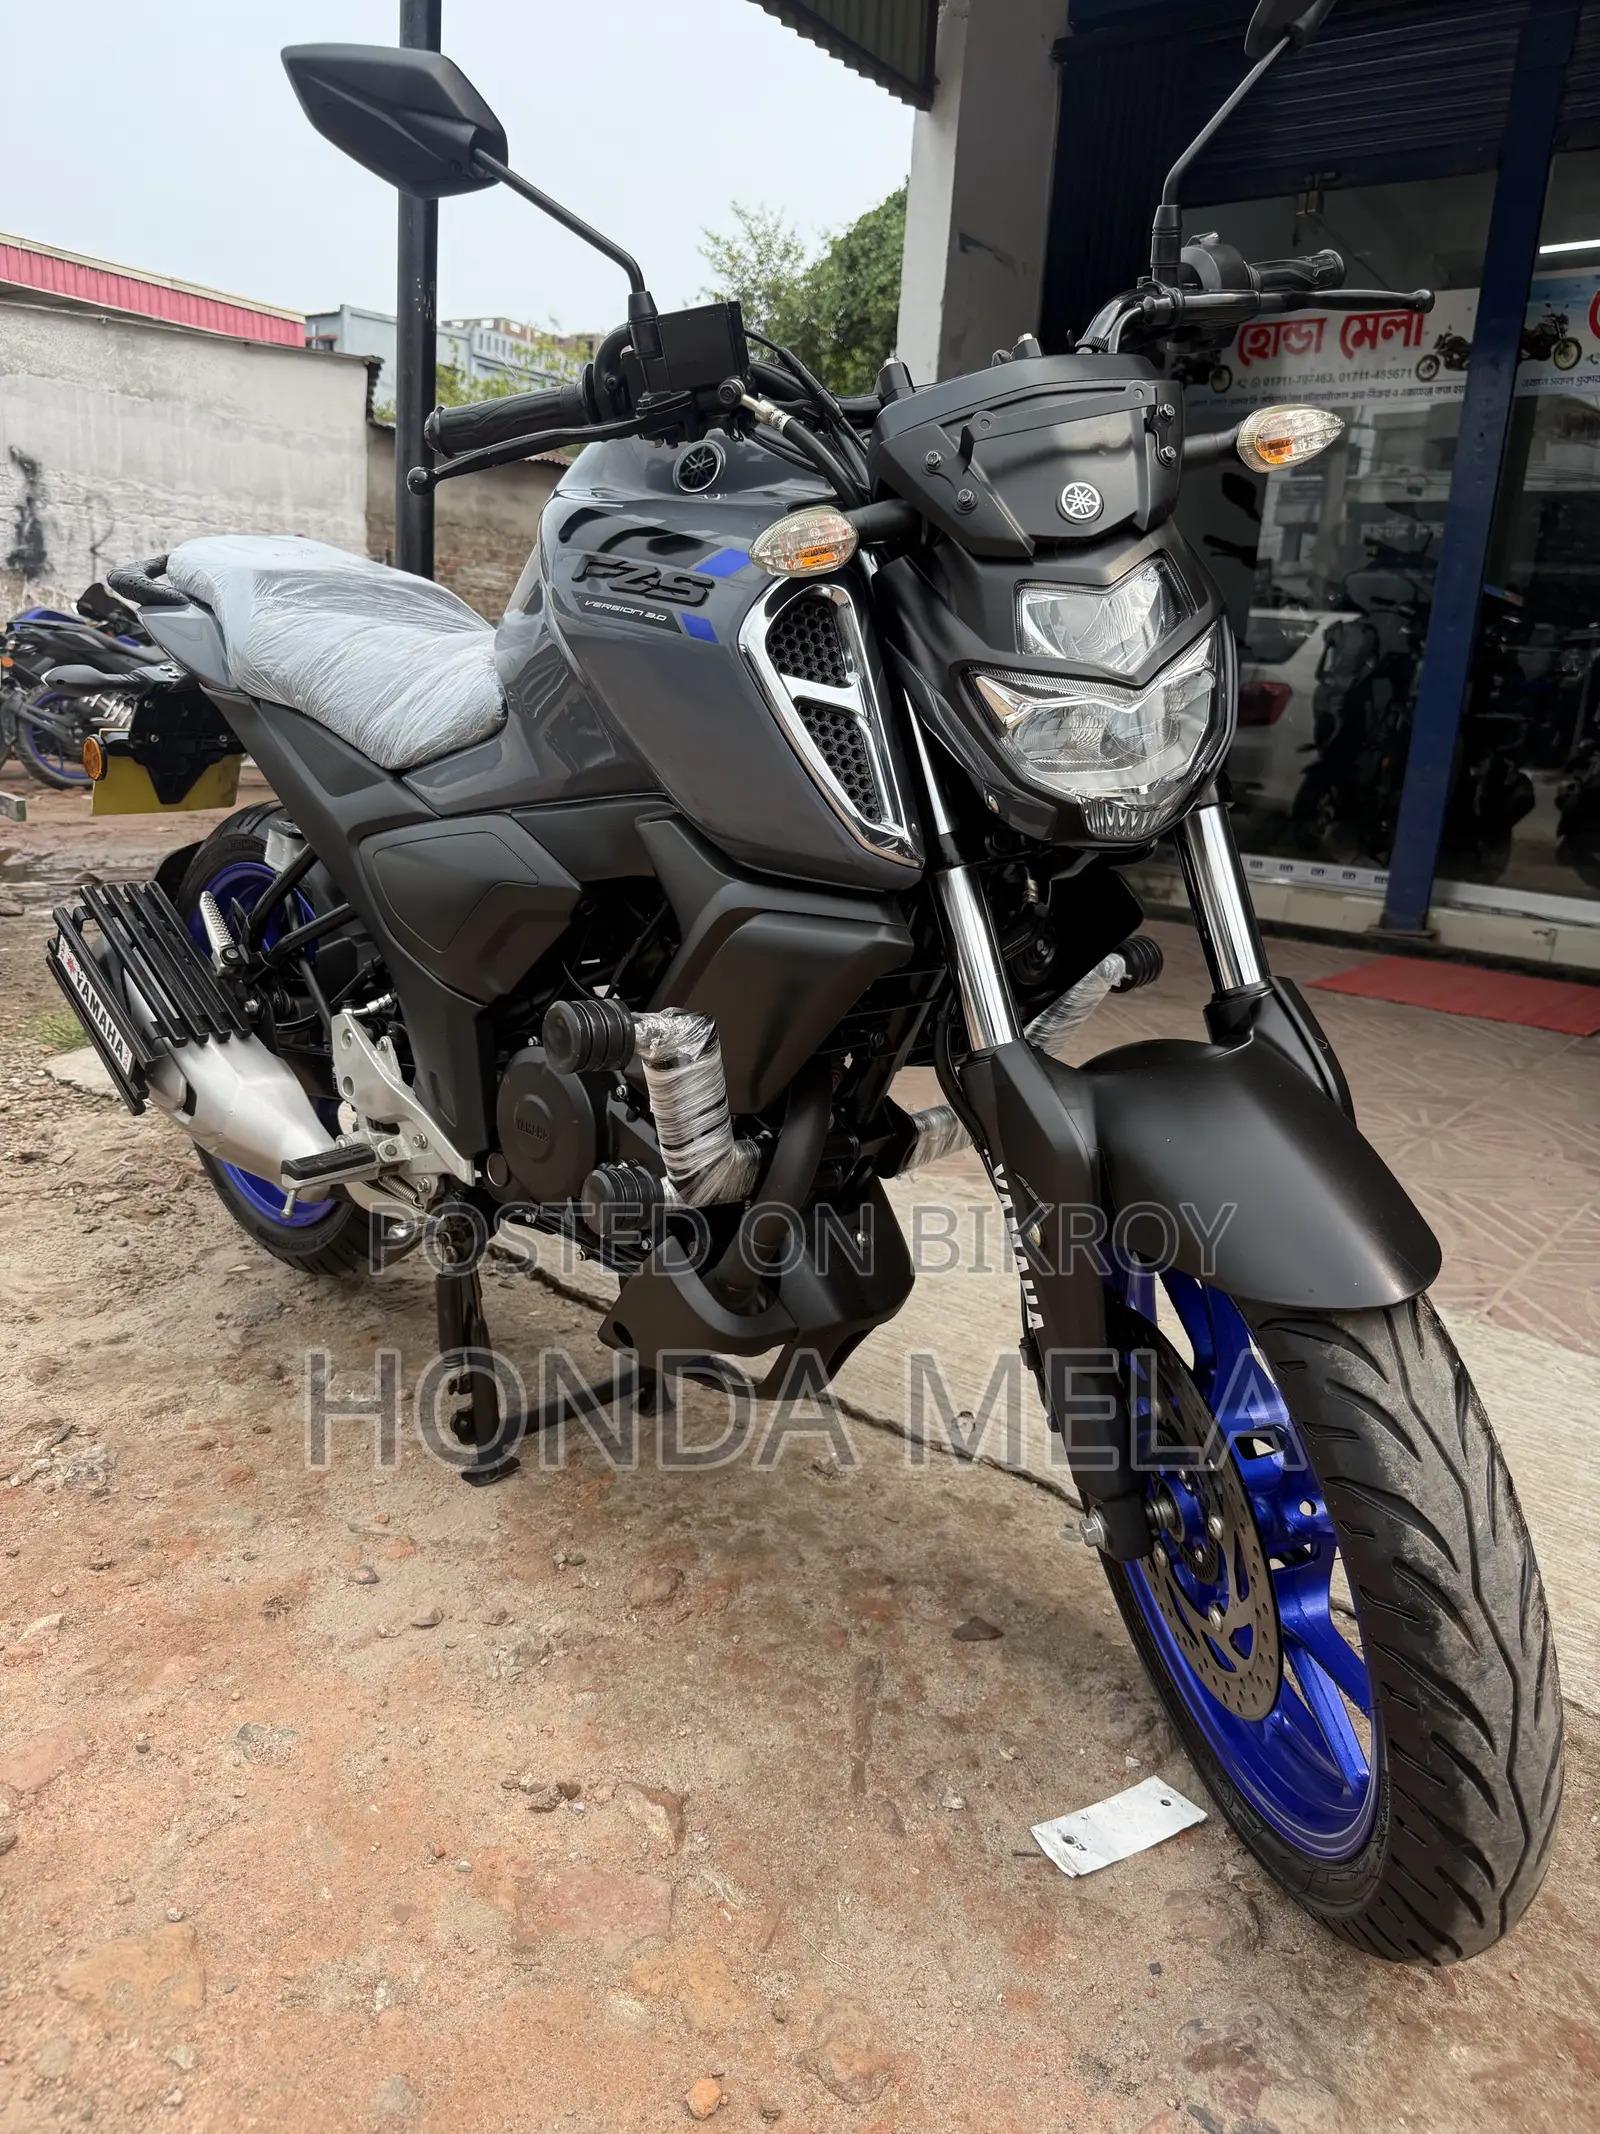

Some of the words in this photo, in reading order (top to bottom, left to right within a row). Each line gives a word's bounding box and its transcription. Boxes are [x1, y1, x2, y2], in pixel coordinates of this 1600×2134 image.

[1236, 317, 1327, 366] হোন্ডা
[1340, 309, 1425, 361] মেলা
[584, 600, 645, 618] VERSION
[644, 611, 668, 622] 3.0
[75, 970, 125, 1062] YAMAHA
[515, 1116, 549, 1142] YAMAHA
